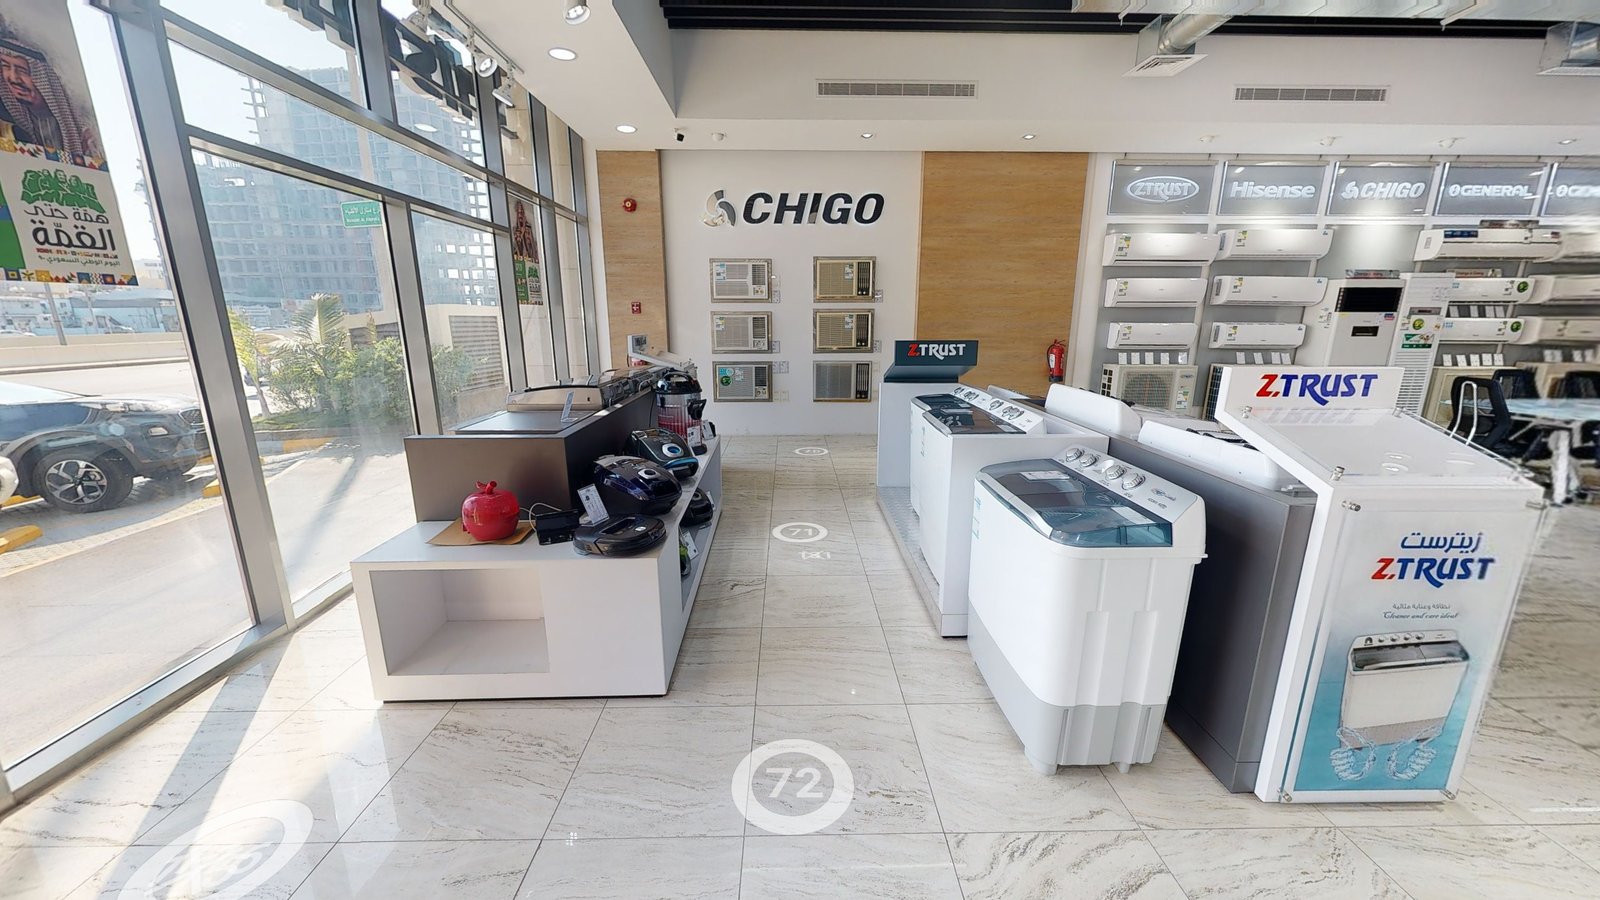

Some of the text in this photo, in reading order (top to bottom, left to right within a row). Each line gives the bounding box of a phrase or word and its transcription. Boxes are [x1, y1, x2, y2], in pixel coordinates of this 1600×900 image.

[1230, 181, 1316, 199] Hisense
[1360, 182, 1426, 199] CHIGO
[742, 192, 885, 225] CHIGO
[1400, 531, 1484, 553] زيترست
